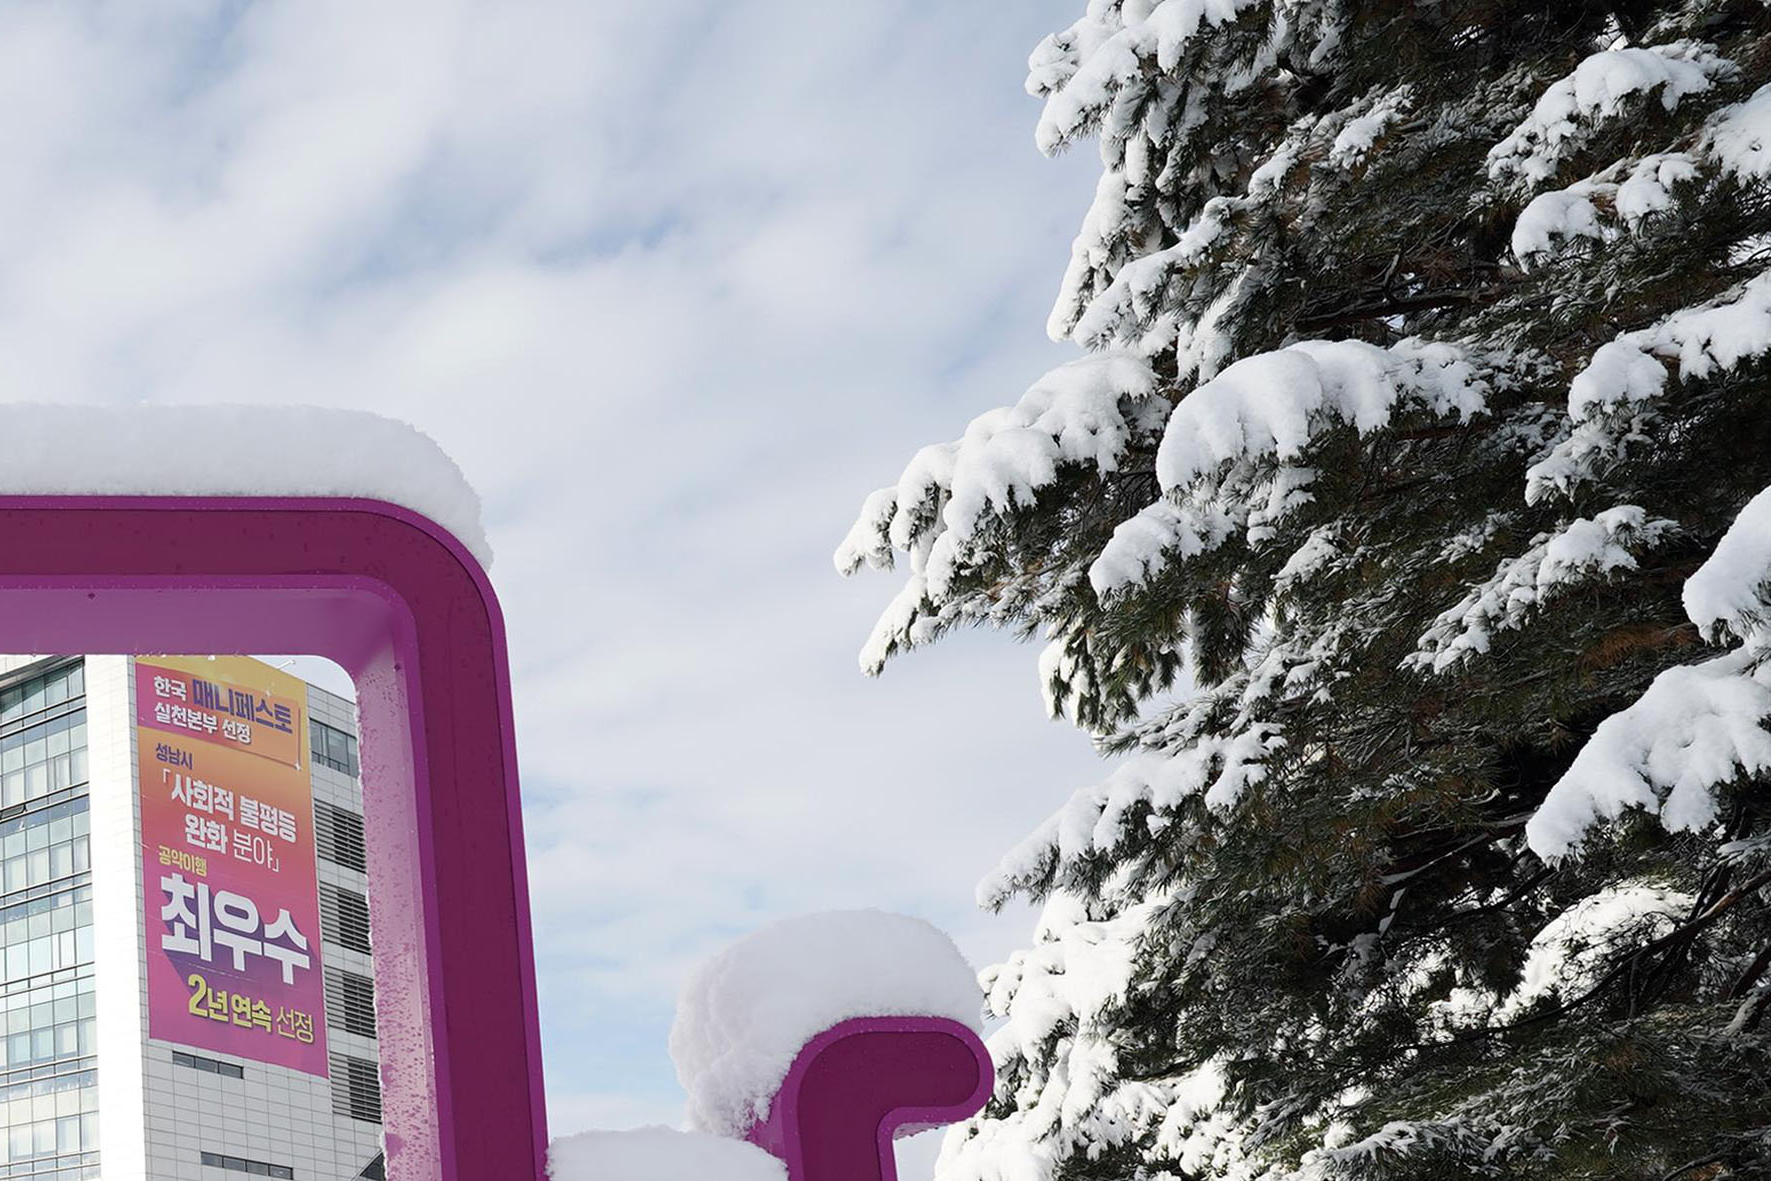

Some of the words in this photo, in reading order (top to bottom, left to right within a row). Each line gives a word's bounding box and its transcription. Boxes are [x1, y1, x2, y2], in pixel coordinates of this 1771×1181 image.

[153, 675, 187, 702] 한국
[192, 678, 294, 735] 매니페스토
[154, 702, 218, 735] 실천본부
[222, 718, 252, 745] 선정
[155, 742, 193, 771] 성남시
[185, 813, 227, 855] 완화
[239, 794, 297, 844] 불평등
[158, 845, 208, 878] 공약이행
[160, 872, 311, 986] 최우수
[276, 1006, 315, 1044] 선정
